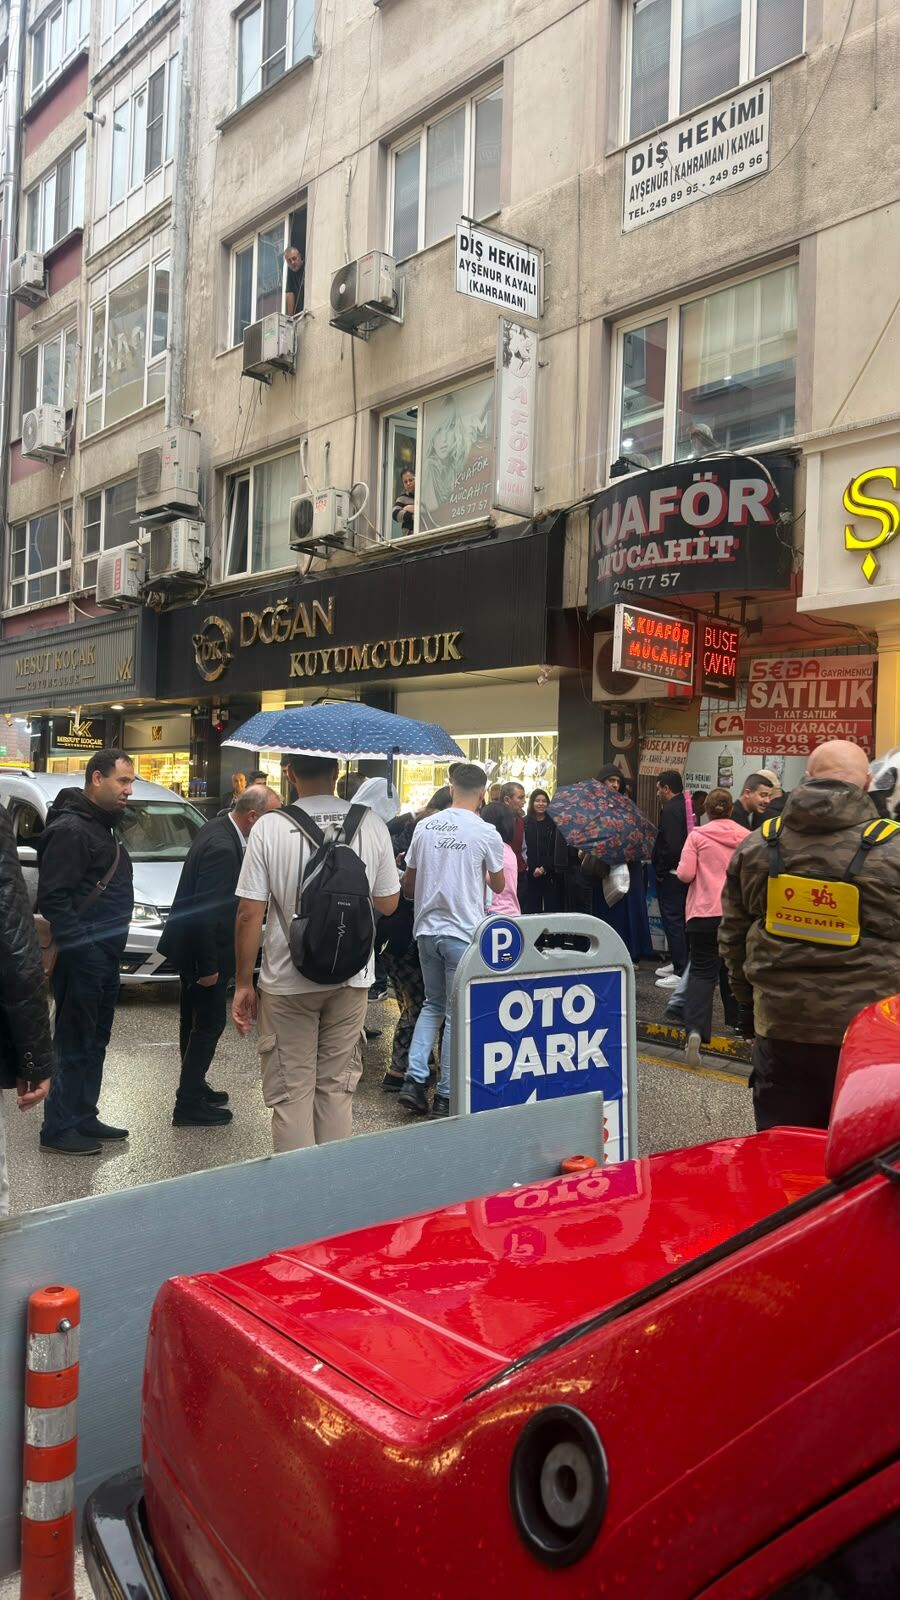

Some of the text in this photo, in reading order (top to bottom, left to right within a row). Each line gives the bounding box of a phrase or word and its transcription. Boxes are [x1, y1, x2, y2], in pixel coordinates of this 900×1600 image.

[631, 87, 764, 176] DİŞ HEKİMİ
[629, 170, 668, 202] AYŞENUR
[731, 125, 764, 154] KAYALI
[670, 190, 683, 203] 89
[686, 183, 698, 196] 95
[709, 168, 729, 187] 249
[731, 161, 745, 176] 89
[749, 154, 763, 168] 96
[459, 234, 536, 278] DİŞ HEKİMİ
[459, 258, 537, 296] AYŞENUR KAYALI
[469, 279, 527, 311] (KAHRAMAN)
[591, 472, 771, 556] KUAFÖR
[843, 466, 900, 584] Ş
[597, 530, 735, 579] MÜCAHİT
[613, 573, 681, 595] 245 77 57
[240, 596, 335, 648] DOĞAN
[636, 616, 690, 645] KUAFÖR
[289, 631, 464, 677] KUYUMCULUK
[629, 639, 692, 668] MÜCAHİT
[704, 626, 737, 653] BUSE
[16, 645, 95, 677] MESUT KOÇAK
[637, 661, 675, 676] 245 77 57
[750, 680, 873, 708] SATILIK
[758, 721, 787, 733] Sibel
[775, 710, 837, 719] 1. KAT SATILIK
[746, 736, 772, 744] 0532
[774, 734, 809, 744] 708
[775, 744, 810, 754] 243
[425, 819, 459, 831] Calvin
[434, 837, 467, 850] Klein
[491, 927, 513, 965] P
[498, 983, 596, 1032] OTO
[483, 1028, 609, 1085] PARK
